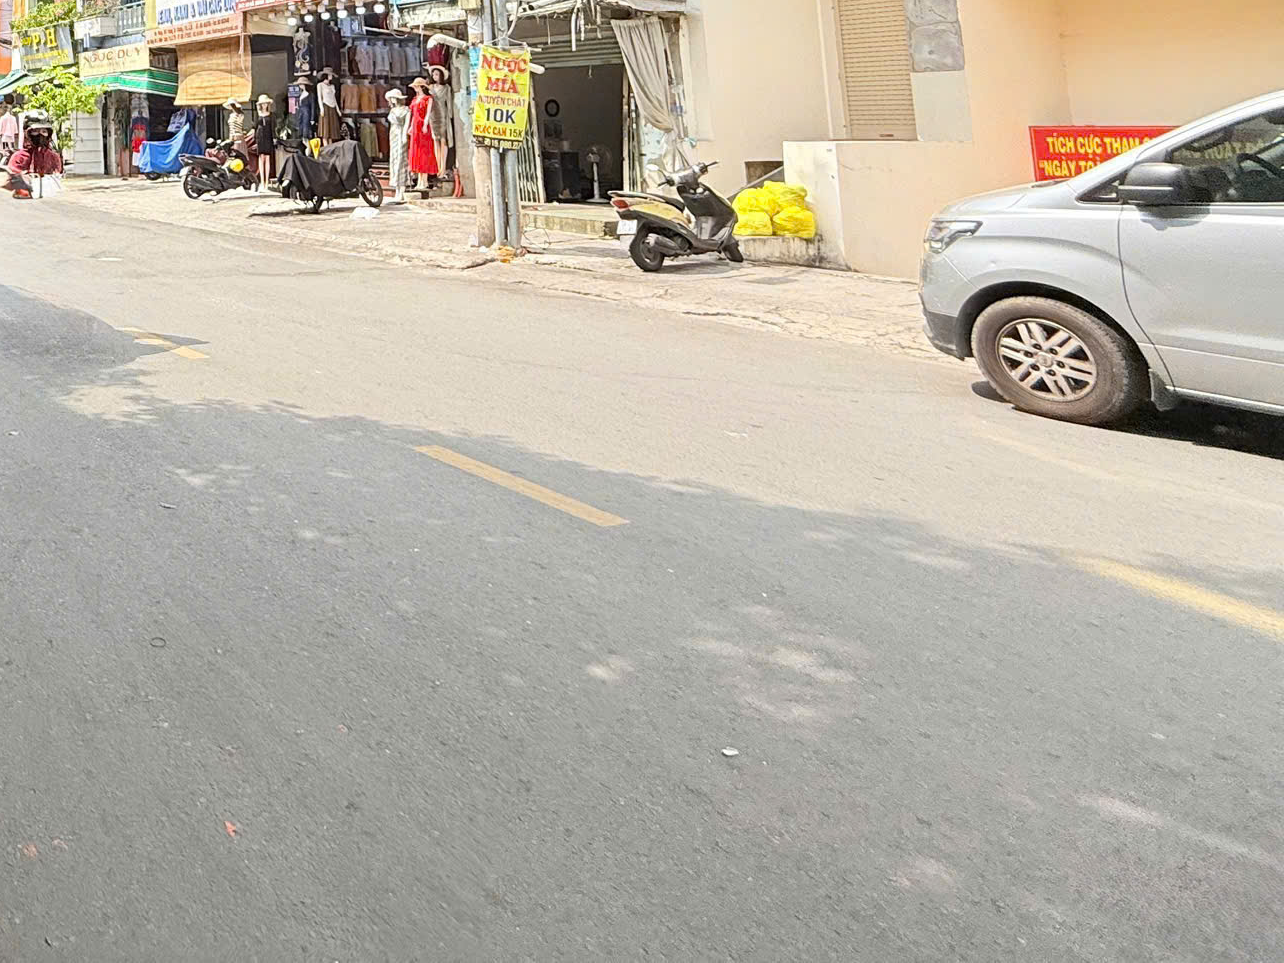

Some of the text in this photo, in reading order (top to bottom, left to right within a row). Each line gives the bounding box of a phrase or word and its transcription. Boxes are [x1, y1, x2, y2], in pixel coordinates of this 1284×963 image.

[485, 75, 519, 94] MÍA
[485, 108, 516, 124] 10K
[1046, 133, 1075, 154] TÍCH
[1076, 134, 1103, 158] CỰC
